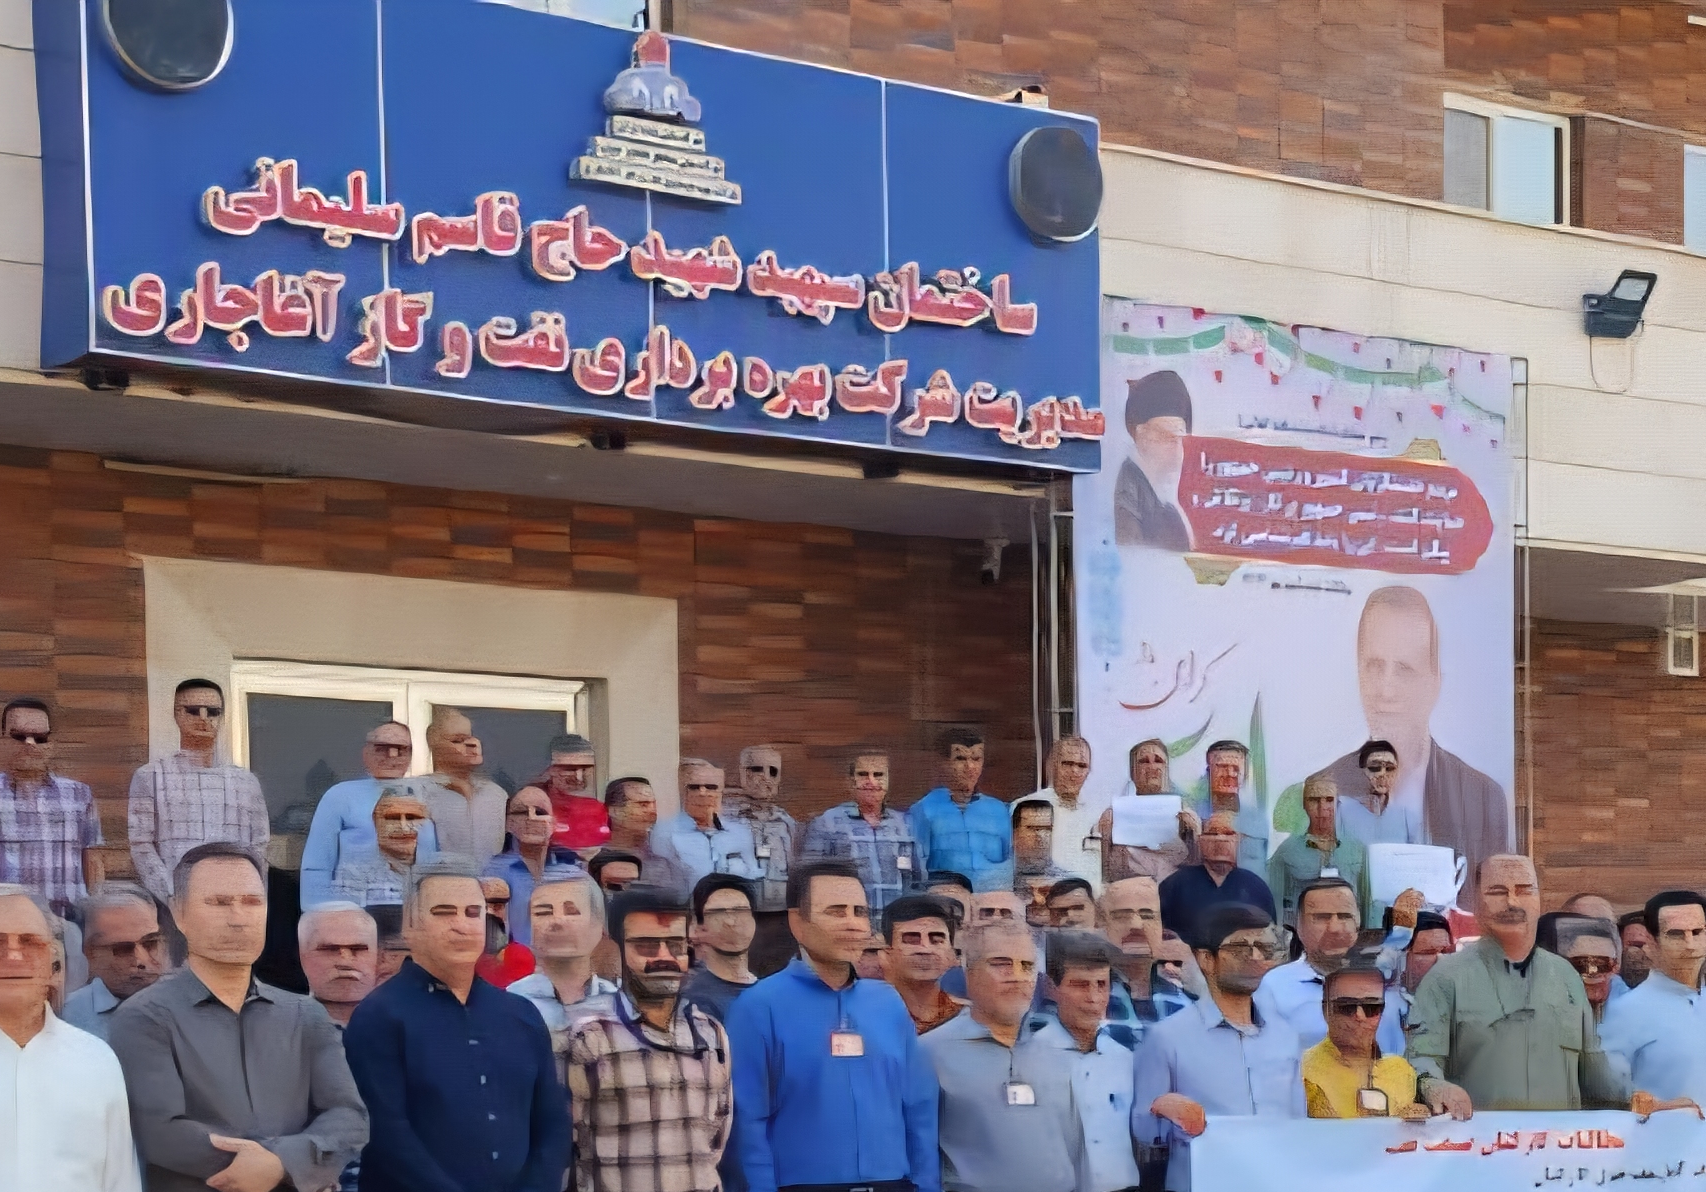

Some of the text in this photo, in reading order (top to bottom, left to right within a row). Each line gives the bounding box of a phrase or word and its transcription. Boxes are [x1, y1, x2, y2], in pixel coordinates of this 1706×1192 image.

[201, 157, 1037, 336] ساختمان سپهبد شهید حاج قاسم سلیمانی
[102, 261, 1106, 449] مدیریت شرکت بهره برداری نفت و گاز آغاجاری
